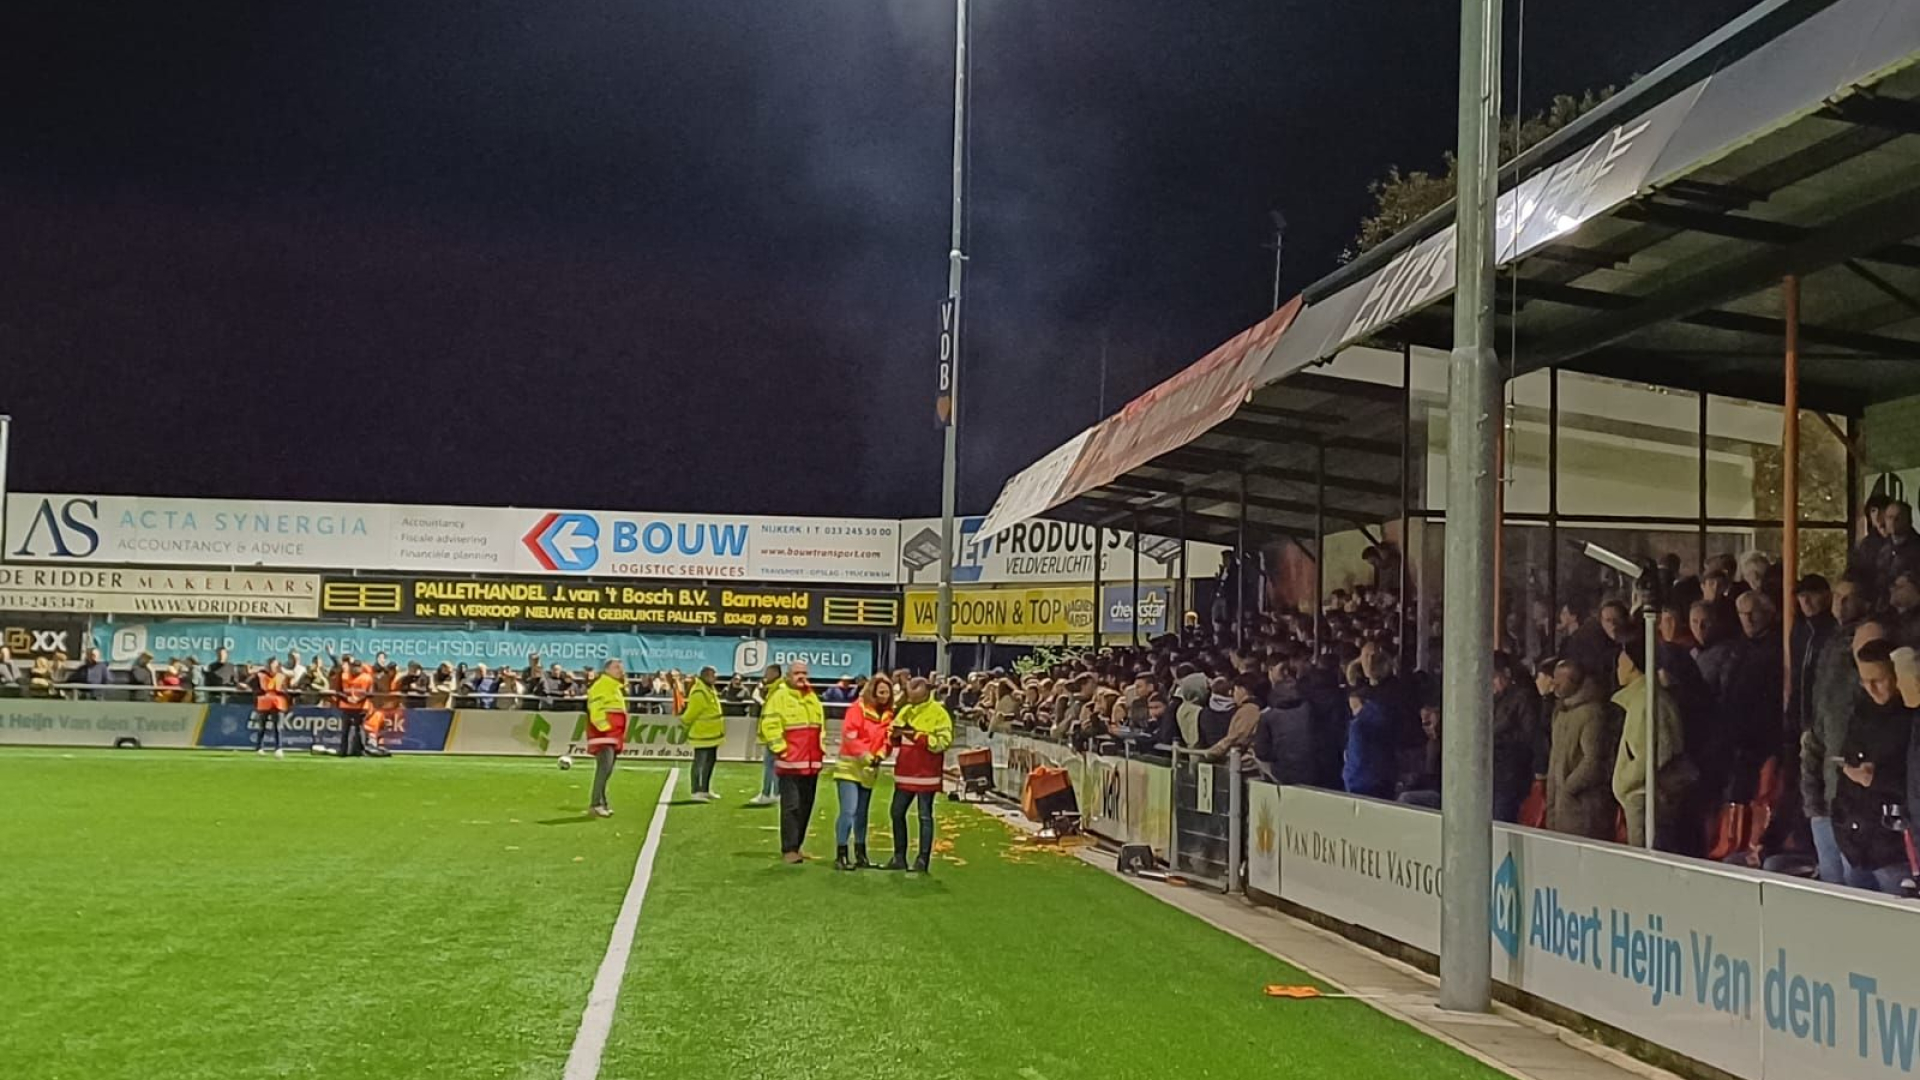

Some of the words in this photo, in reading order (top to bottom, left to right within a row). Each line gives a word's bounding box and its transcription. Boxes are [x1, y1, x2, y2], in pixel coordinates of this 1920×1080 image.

[941, 302, 953, 391] VDB
[120, 510, 197, 530] ACTA
[216, 513, 367, 536] SYNERGIA
[401, 518, 464, 529] Accountancy
[761, 525, 801, 535] NIJKERK
[825, 526, 842, 535] 033
[845, 527, 862, 536] 245
[879, 528, 892, 536] 00
[118, 539, 231, 553] ACCOUNTANCY
[237, 543, 246, 553] &
[251, 543, 303, 555] ADVICE
[613, 521, 749, 556] BOUW
[996, 521, 1121, 553] PRODUCS
[453, 551, 498, 562] planning
[761, 547, 881, 559] www.bouwtransport.com
[1006, 553, 1108, 575] VELDVERLICHTIG
[0, 569, 23, 585] DE
[35, 569, 122, 588] RIDDER
[138, 576, 314, 592] MAKELAARS
[611, 563, 674, 576] LOGISTIC
[680, 565, 745, 577] SERVICES
[134, 597, 294, 614] WWW.VDRIDDER.NL
[415, 582, 546, 601] PALLETHANDEL
[623, 587, 673, 604] Bosch
[679, 590, 710, 606] B.V.
[721, 590, 809, 609] Barneveld
[439, 604, 456, 617] EN
[460, 605, 520, 618] VERKOOP
[525, 606, 574, 619] NIEUWE
[577, 607, 595, 620] EN
[598, 608, 665, 623] GEBRUIKTE
[667, 610, 716, 624] PALLETS
[776, 614, 789, 626] 28
[793, 615, 807, 627] 90
[914, 601, 938, 625] VA
[1012, 600, 1024, 625] &
[1029, 598, 1062, 624] TOP
[155, 636, 235, 651] BOSVELD
[257, 636, 336, 652] INCASSO
[341, 639, 364, 655] EN
[369, 639, 609, 660] GERECHTSDEURWAARDERS
[775, 651, 852, 666] BOSVELD
[1530, 886, 1601, 970] Albert
[1611, 908, 1681, 1006] Heijn
[1690, 930, 1751, 1021] Van
[1763, 948, 1836, 1048] den
